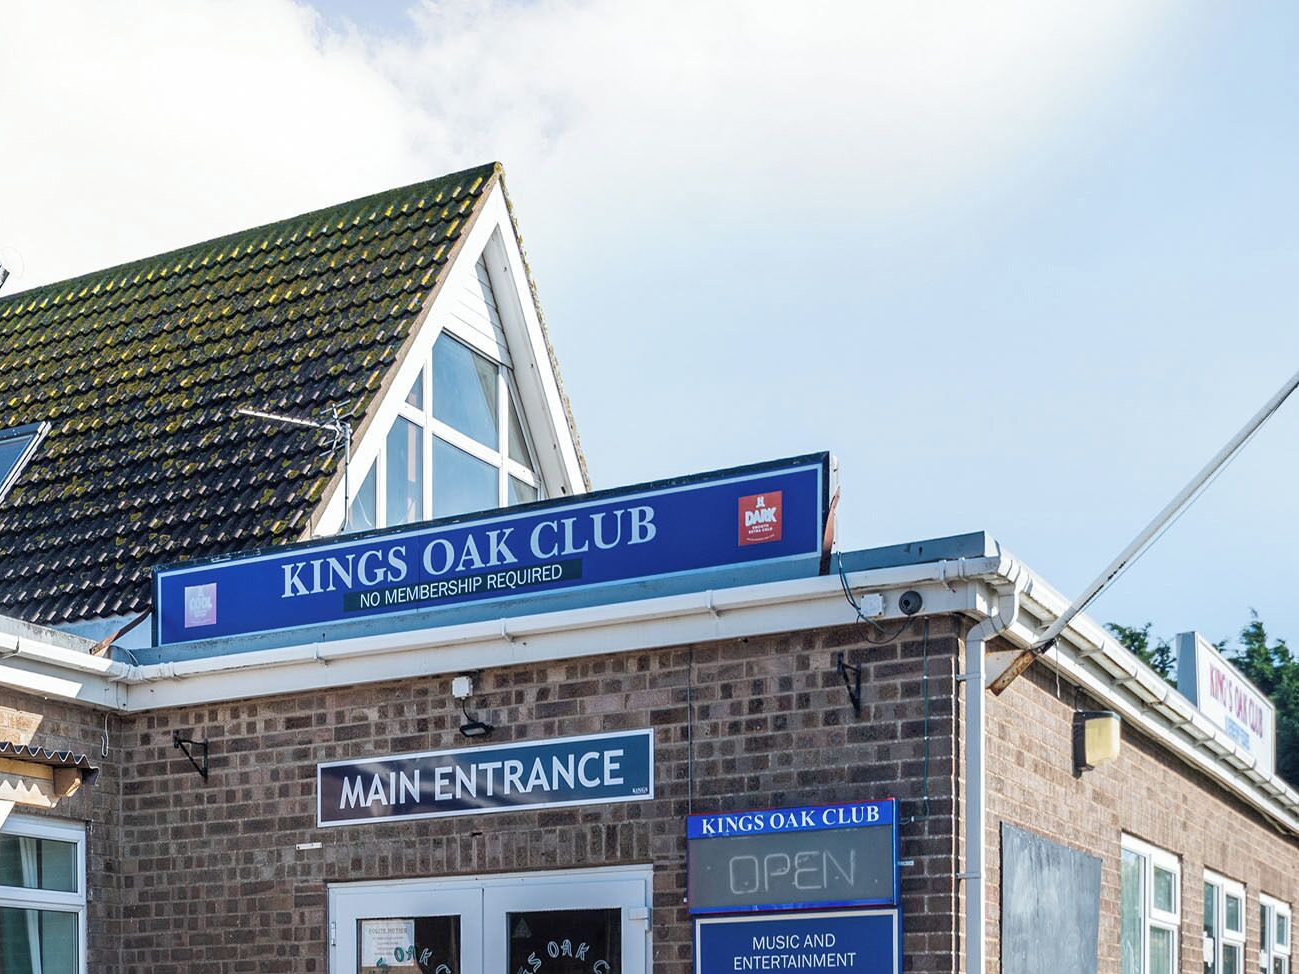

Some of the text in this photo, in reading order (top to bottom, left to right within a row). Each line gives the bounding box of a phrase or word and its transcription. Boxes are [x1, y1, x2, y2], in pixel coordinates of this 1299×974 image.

[744, 507, 777, 527] DARK
[281, 505, 657, 598] KINGS OAK CLUB
[359, 564, 563, 608] NO MEMBERSHIP REQUIRED
[339, 749, 624, 810] MAIN ENTRANCE
[702, 805, 879, 834] KINGS OAK CLUB
[729, 848, 856, 895] OPEN
[547, 939, 590, 961] OAK
[752, 933, 836, 950] MUSIC AND
[734, 952, 856, 970] ENTERTAINMENT
